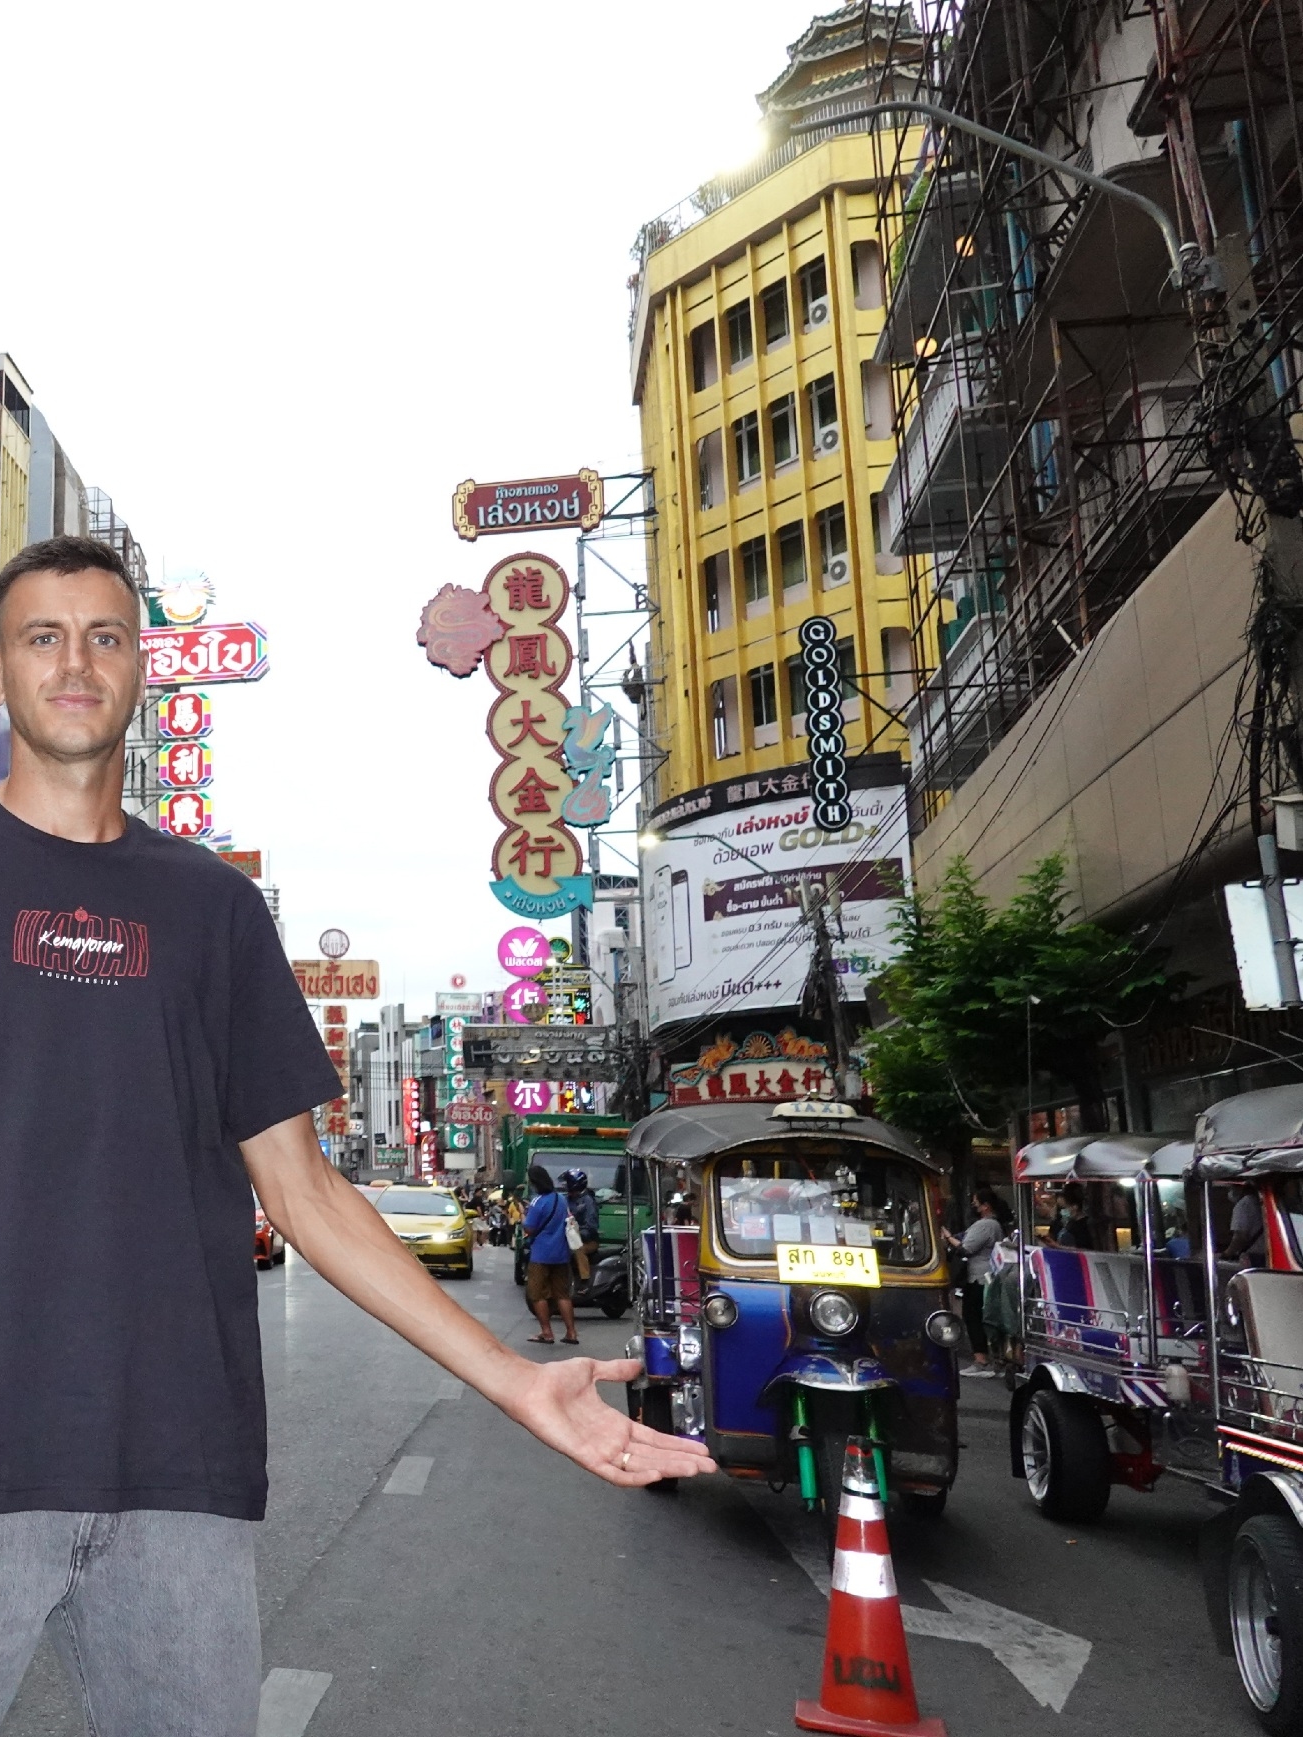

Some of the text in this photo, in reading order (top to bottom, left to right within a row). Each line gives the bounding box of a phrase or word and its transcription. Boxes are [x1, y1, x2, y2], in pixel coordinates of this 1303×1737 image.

[495, 484, 559, 500] ห้างขายทอง
[477, 490, 581, 529] เล่งหงษ์
[140, 635, 185, 649] งทอง
[146, 630, 253, 677] องใบ
[502, 566, 566, 878] 龍鳳大金行
[809, 624, 841, 823] GOLDSMITH
[736, 805, 811, 835] เล่งหงษ์
[38, 929, 125, 965] Kemayoran
[504, 956, 543, 967] Wacoal
[790, 1102, 845, 1115] TAXI
[832, 1250, 865, 1267] 891
